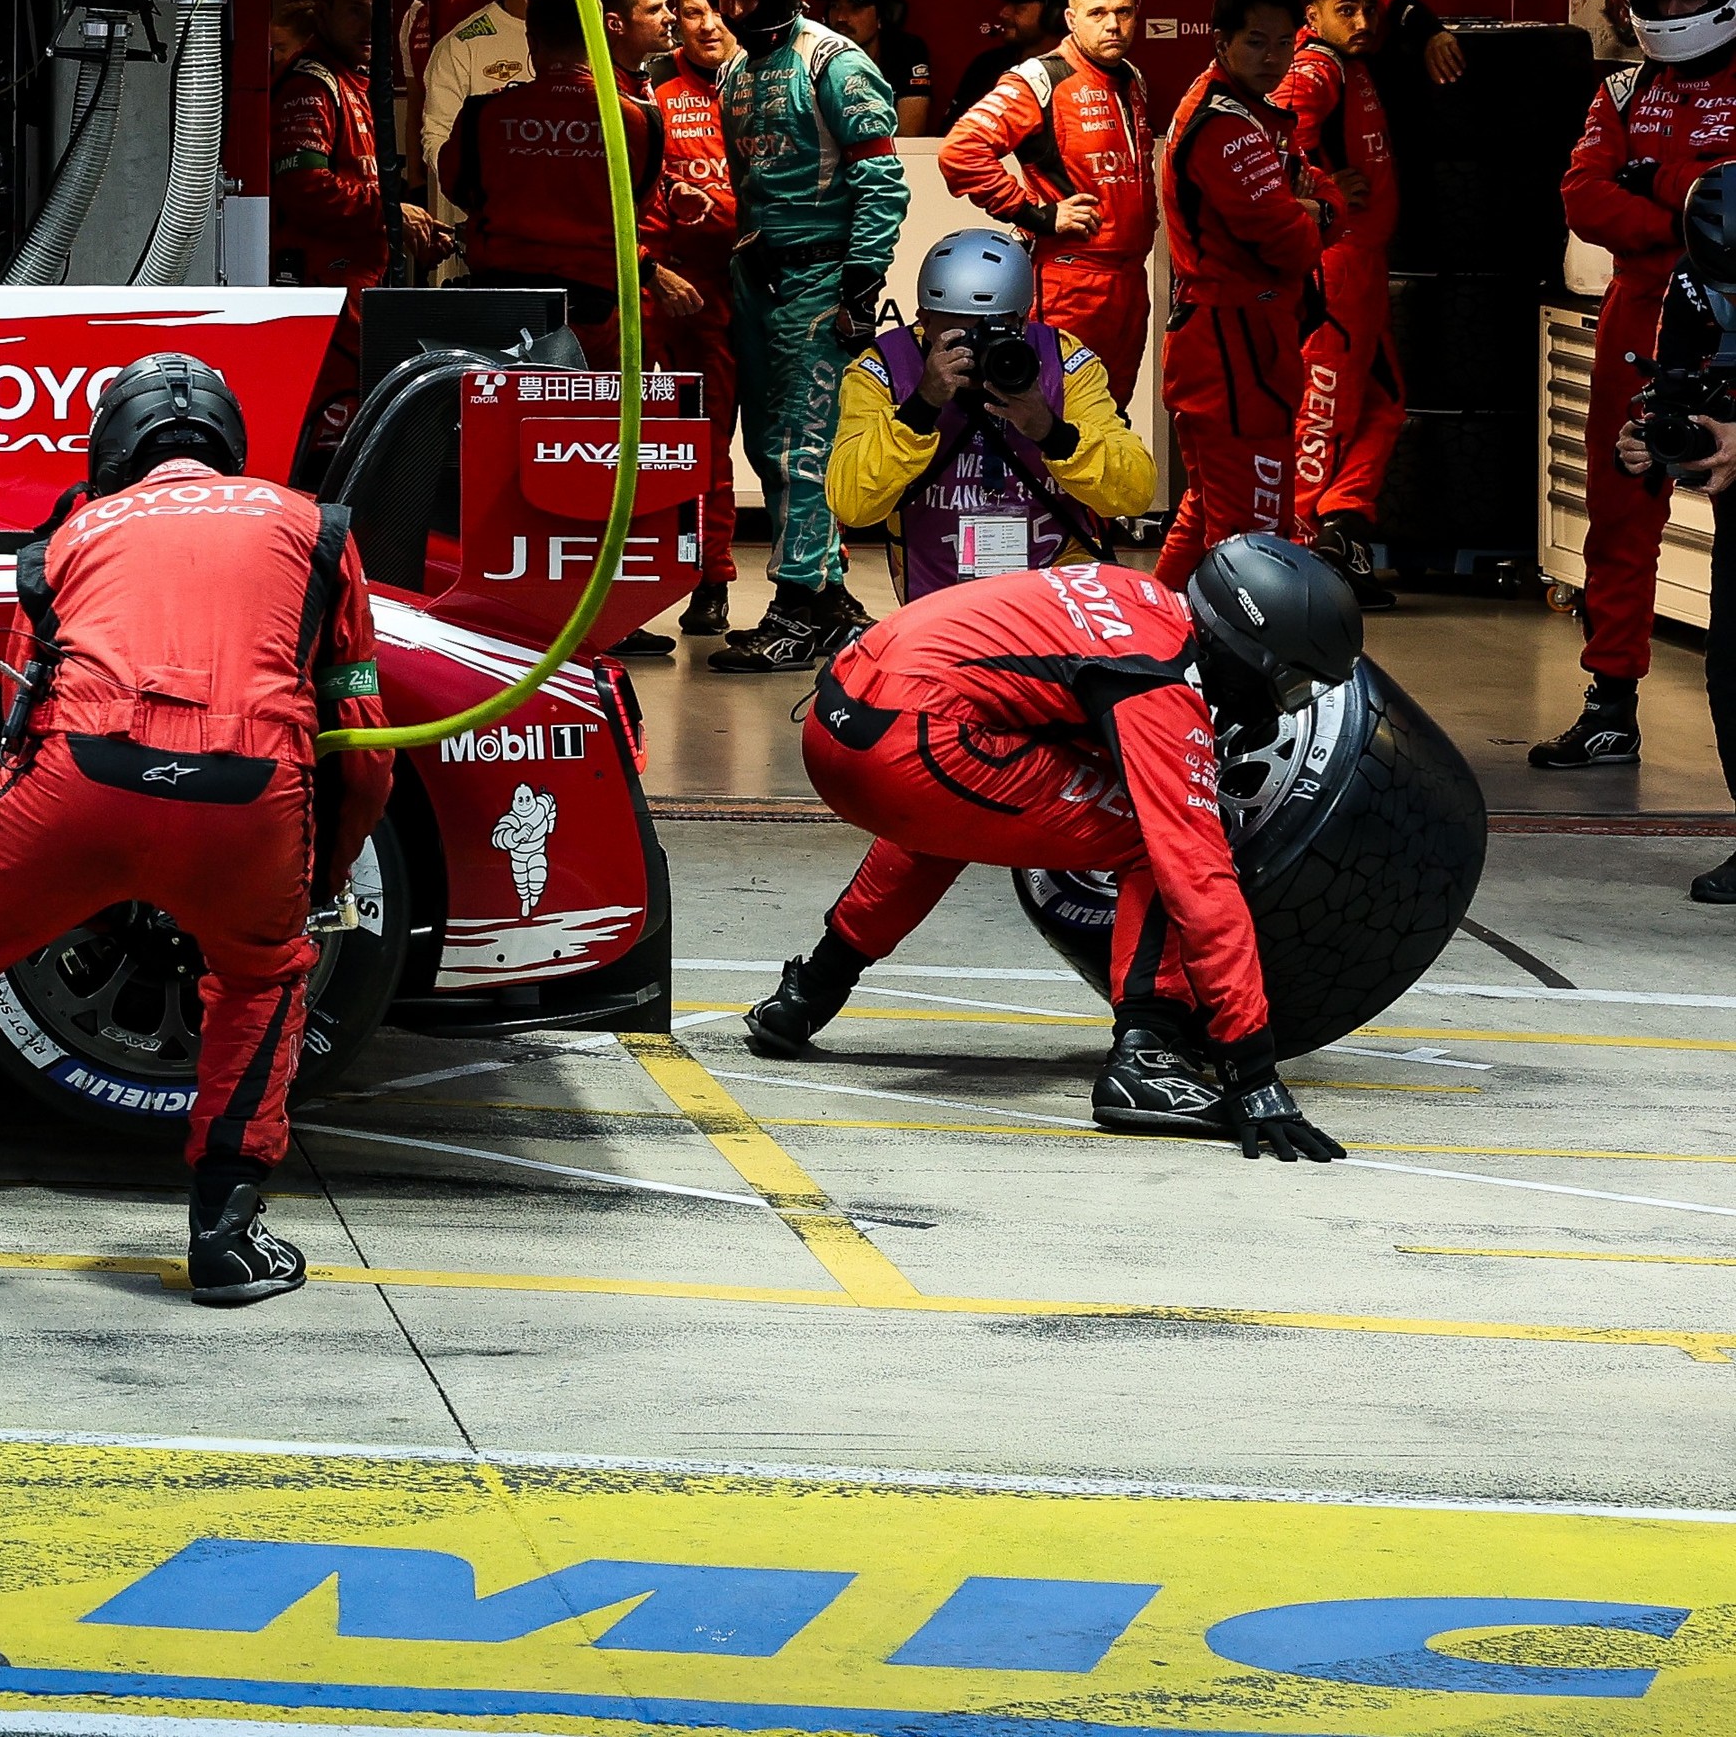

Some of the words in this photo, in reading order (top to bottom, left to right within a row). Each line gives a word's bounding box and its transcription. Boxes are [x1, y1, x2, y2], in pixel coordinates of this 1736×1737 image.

[517, 376, 675, 402] 豊田自動機
[1295, 364, 1337, 484] DENSO
[534, 443, 697, 463] HAYASHI
[68, 484, 283, 533] TOYOTA
[483, 536, 660, 582] JFE
[441, 724, 544, 762] Mobil
